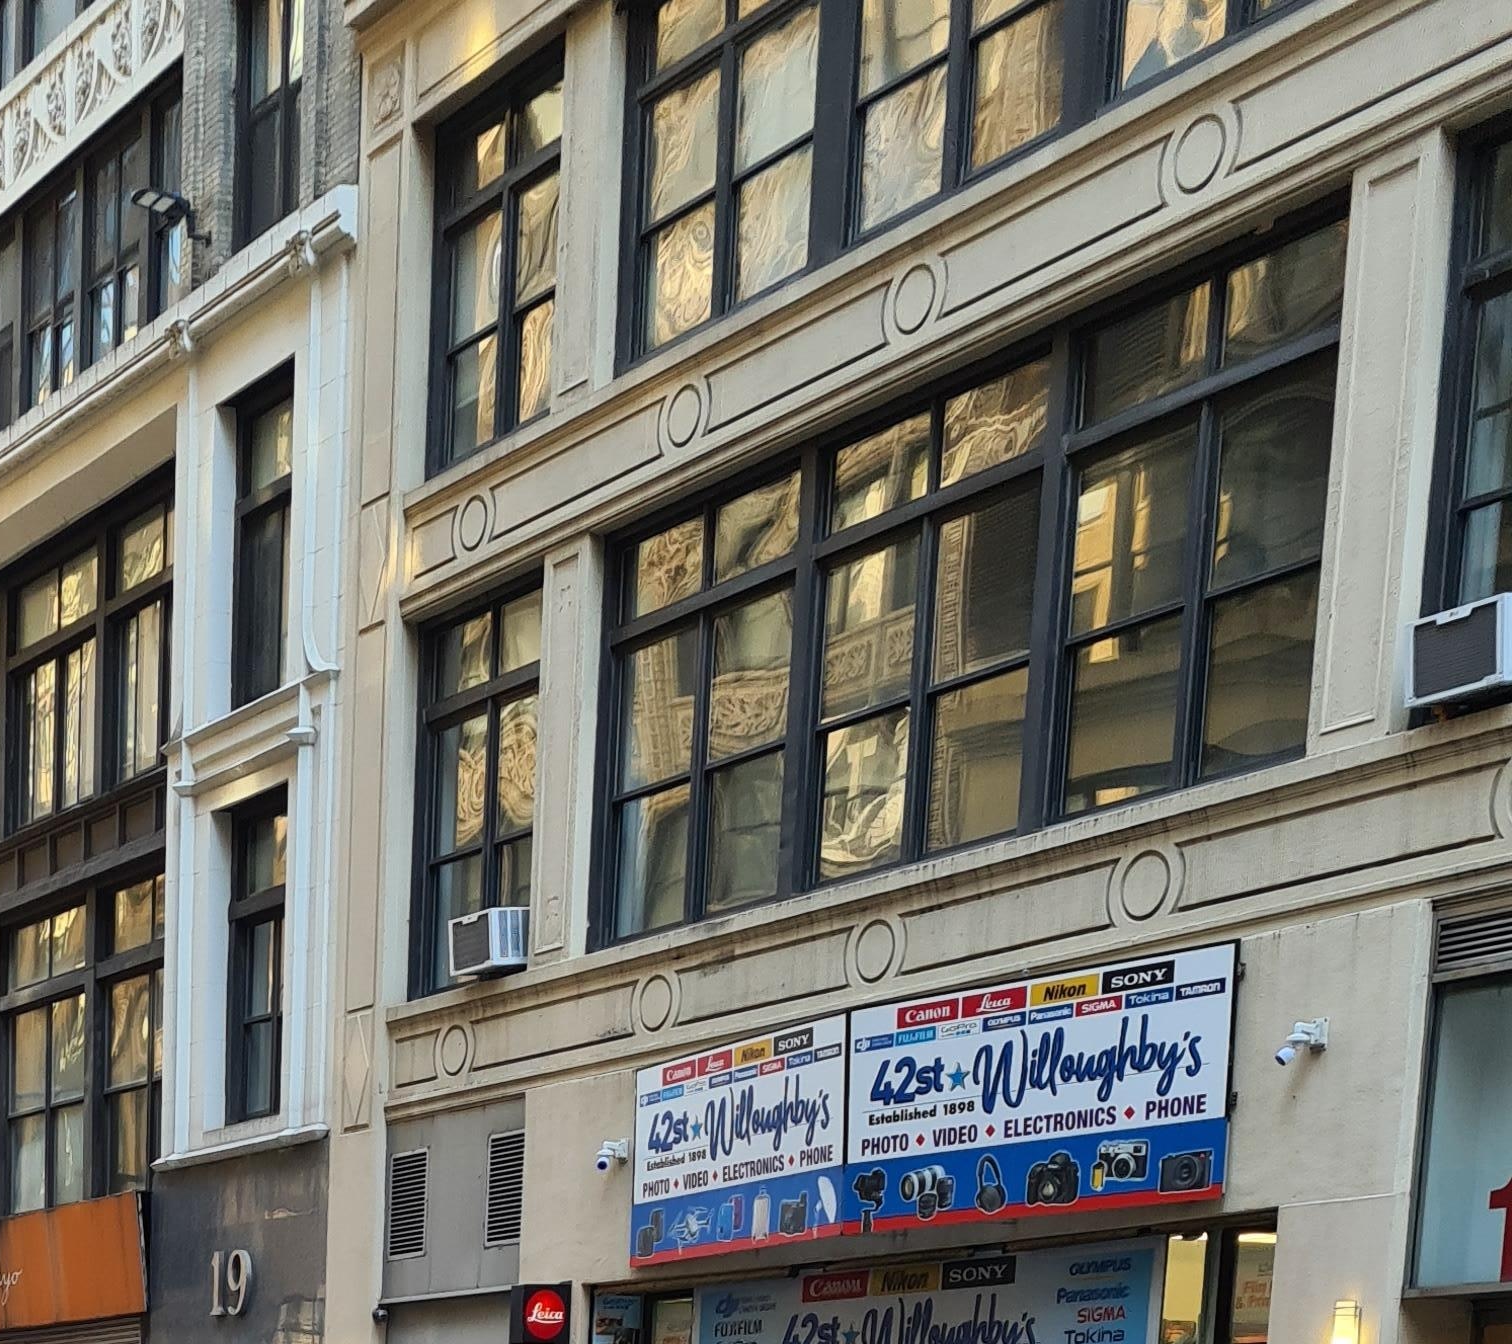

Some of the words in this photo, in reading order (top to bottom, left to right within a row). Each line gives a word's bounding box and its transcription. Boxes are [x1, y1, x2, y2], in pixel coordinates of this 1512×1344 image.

[905, 1006, 951, 1023] Canon
[976, 993, 1011, 1012] Leica
[1043, 983, 1086, 1002] Nikon
[1110, 968, 1168, 989] SONY
[898, 1030, 934, 1044] FUJIFILM
[987, 1014, 1021, 1026] OLYMPUS
[1030, 1006, 1072, 1021] Panasonic
[1081, 999, 1117, 1014] SIGMA
[1128, 991, 1170, 1005] Tokina
[1180, 982, 1221, 997] TAMRON
[666, 1065, 691, 1082] Canon
[741, 1047, 766, 1063] Nikon
[778, 1034, 810, 1051] SONY
[870, 1057, 945, 1106] 42st
[972, 1014, 1202, 1114] Willoughby's
[648, 1110, 689, 1153] 42st
[704, 1074, 830, 1161] Willoughby's
[861, 1133, 909, 1156] PHOTO
[933, 1124, 978, 1147] VIDEO
[1004, 1106, 1117, 1139] ELECTRONICS
[1145, 1093, 1207, 1121] PHONE
[868, 1104, 937, 1126] Established
[943, 1100, 975, 1116] 1898
[643, 1178, 670, 1198] PHOTO
[682, 1171, 709, 1191] VIDEO
[723, 1154, 784, 1182] ELECTRONICS
[800, 1145, 833, 1167] PHONE
[647, 1155, 685, 1171] Established
[688, 1149, 706, 1162] 1898
[209, 1249, 252, 1316] 19
[809, 1277, 862, 1298] Canon
[881, 1271, 929, 1292] Nikon
[949, 1264, 1008, 1283] SONY
[1069, 1257, 1132, 1276] OLYMPUS
[1056, 1282, 1131, 1304] Panasonic
[527, 1302, 564, 1324] Leica
[714, 1320, 763, 1338] FUJIFILM
[1077, 1305, 1126, 1324] SIGMA
[1064, 1326, 1125, 1344] Tokina
